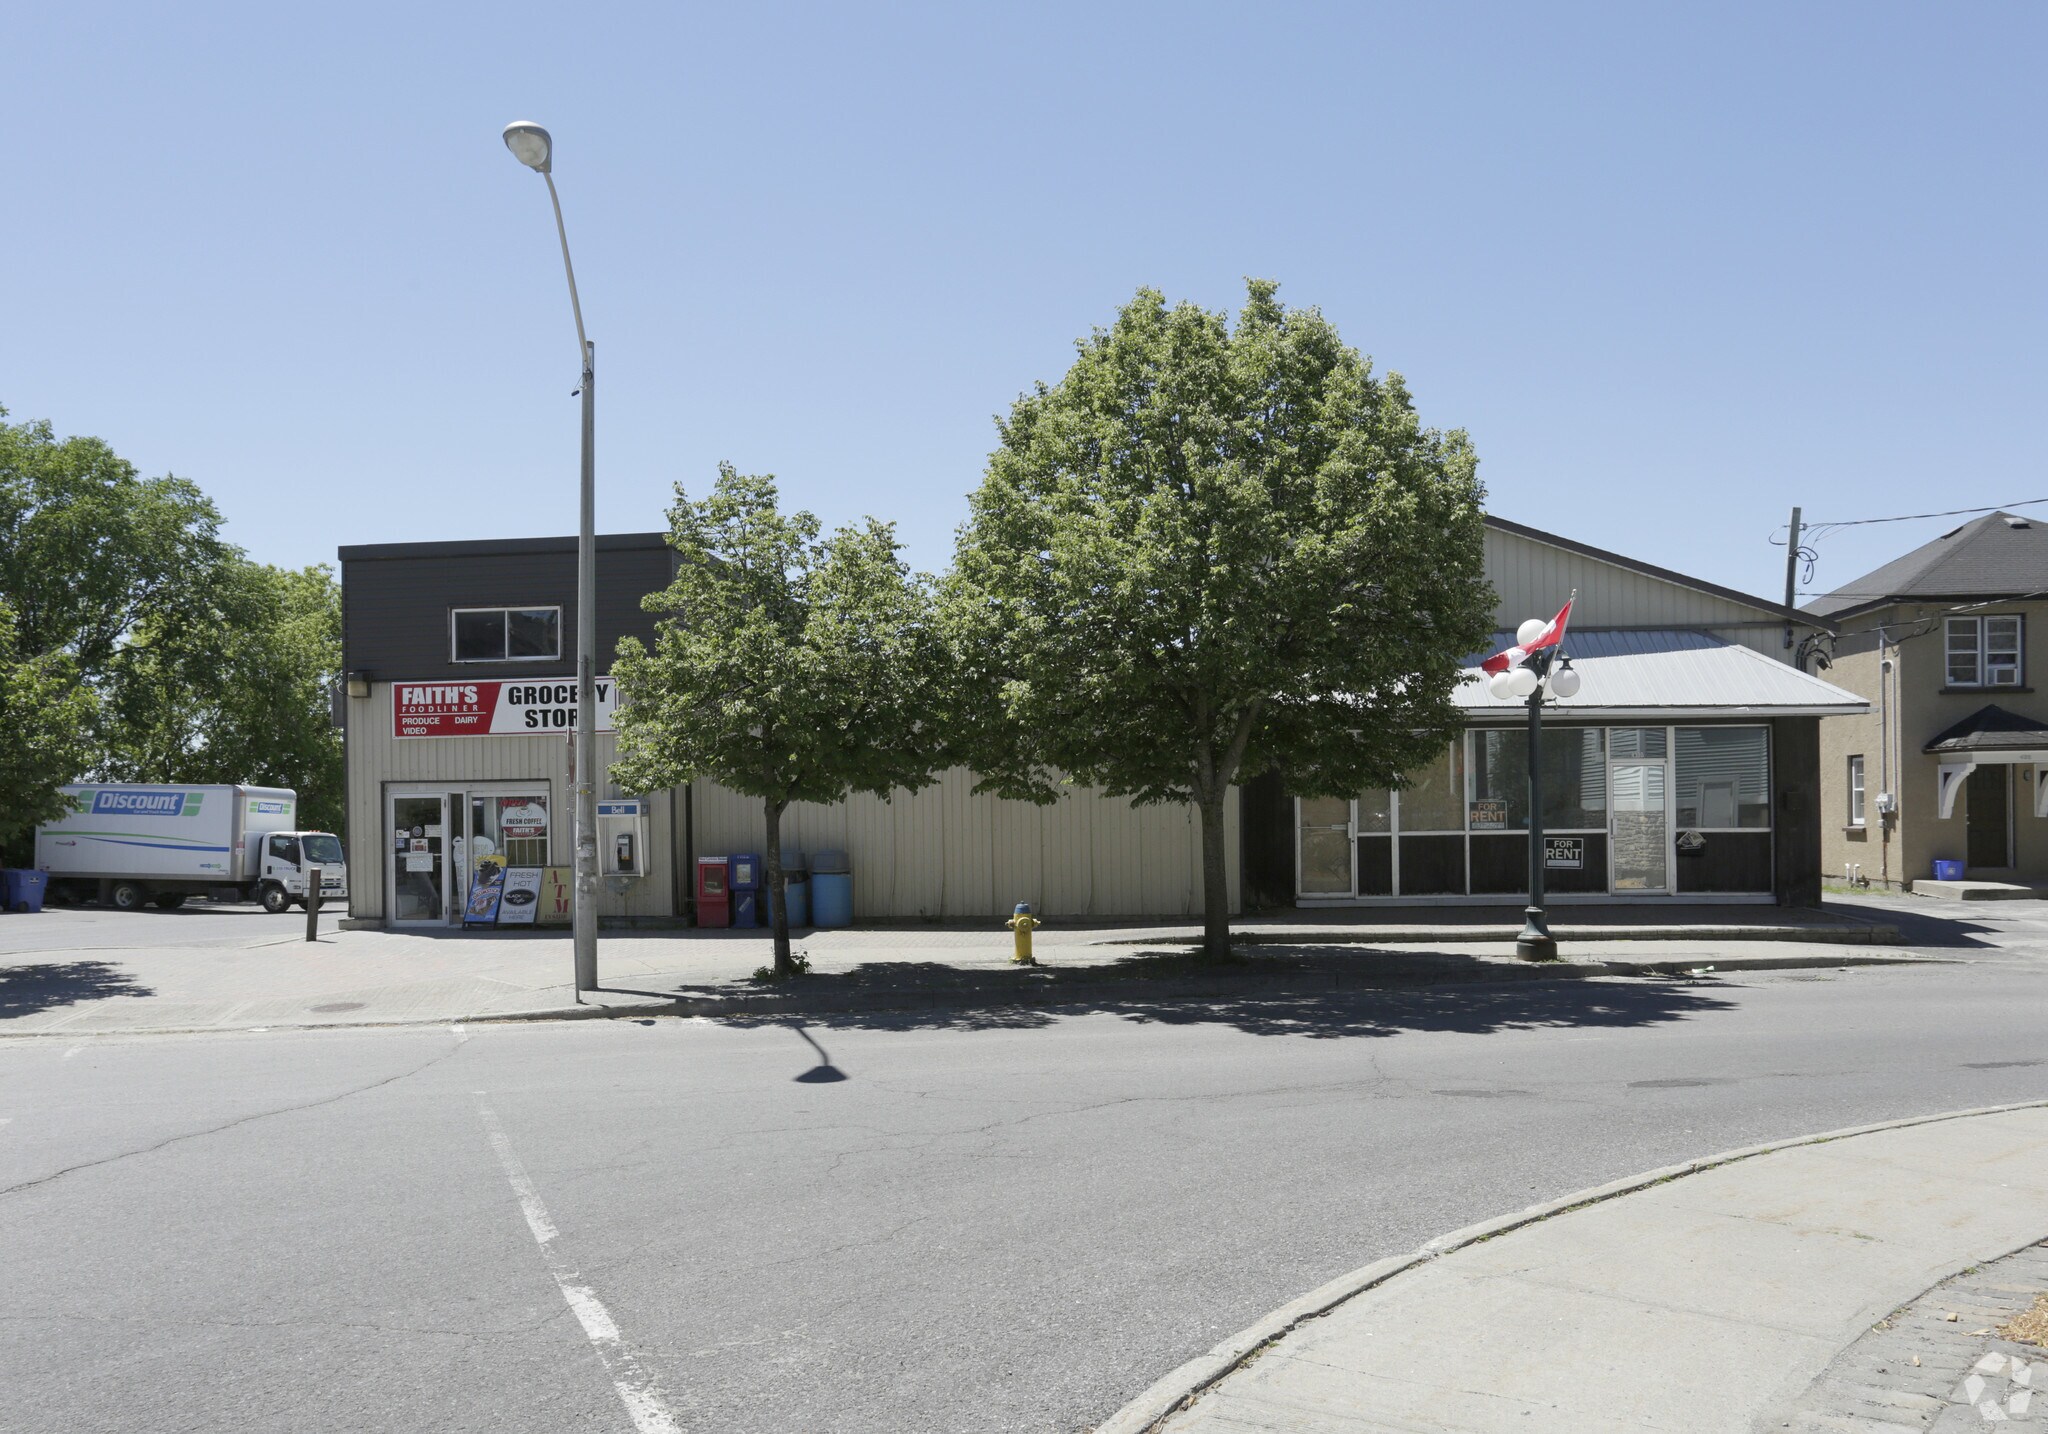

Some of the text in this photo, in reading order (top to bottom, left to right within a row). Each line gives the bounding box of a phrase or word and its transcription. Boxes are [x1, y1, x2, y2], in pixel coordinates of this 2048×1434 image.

[402, 686, 478, 705] FAITH'S
[508, 684, 609, 705] GROCEY
[402, 705, 478, 713] FOODLINER
[402, 716, 478, 725] PRODUCE DAIRY
[525, 709, 578, 728] STOR
[402, 727, 427, 735] VIDEO
[99, 792, 178, 810] Discount
[1478, 802, 1497, 810] FOR
[611, 805, 625, 815] Bell
[1470, 811, 1505, 822] RENT
[1554, 840, 1573, 848] FOR
[1545, 848, 1582, 860] RENT
[509, 871, 539, 879] FRESH
